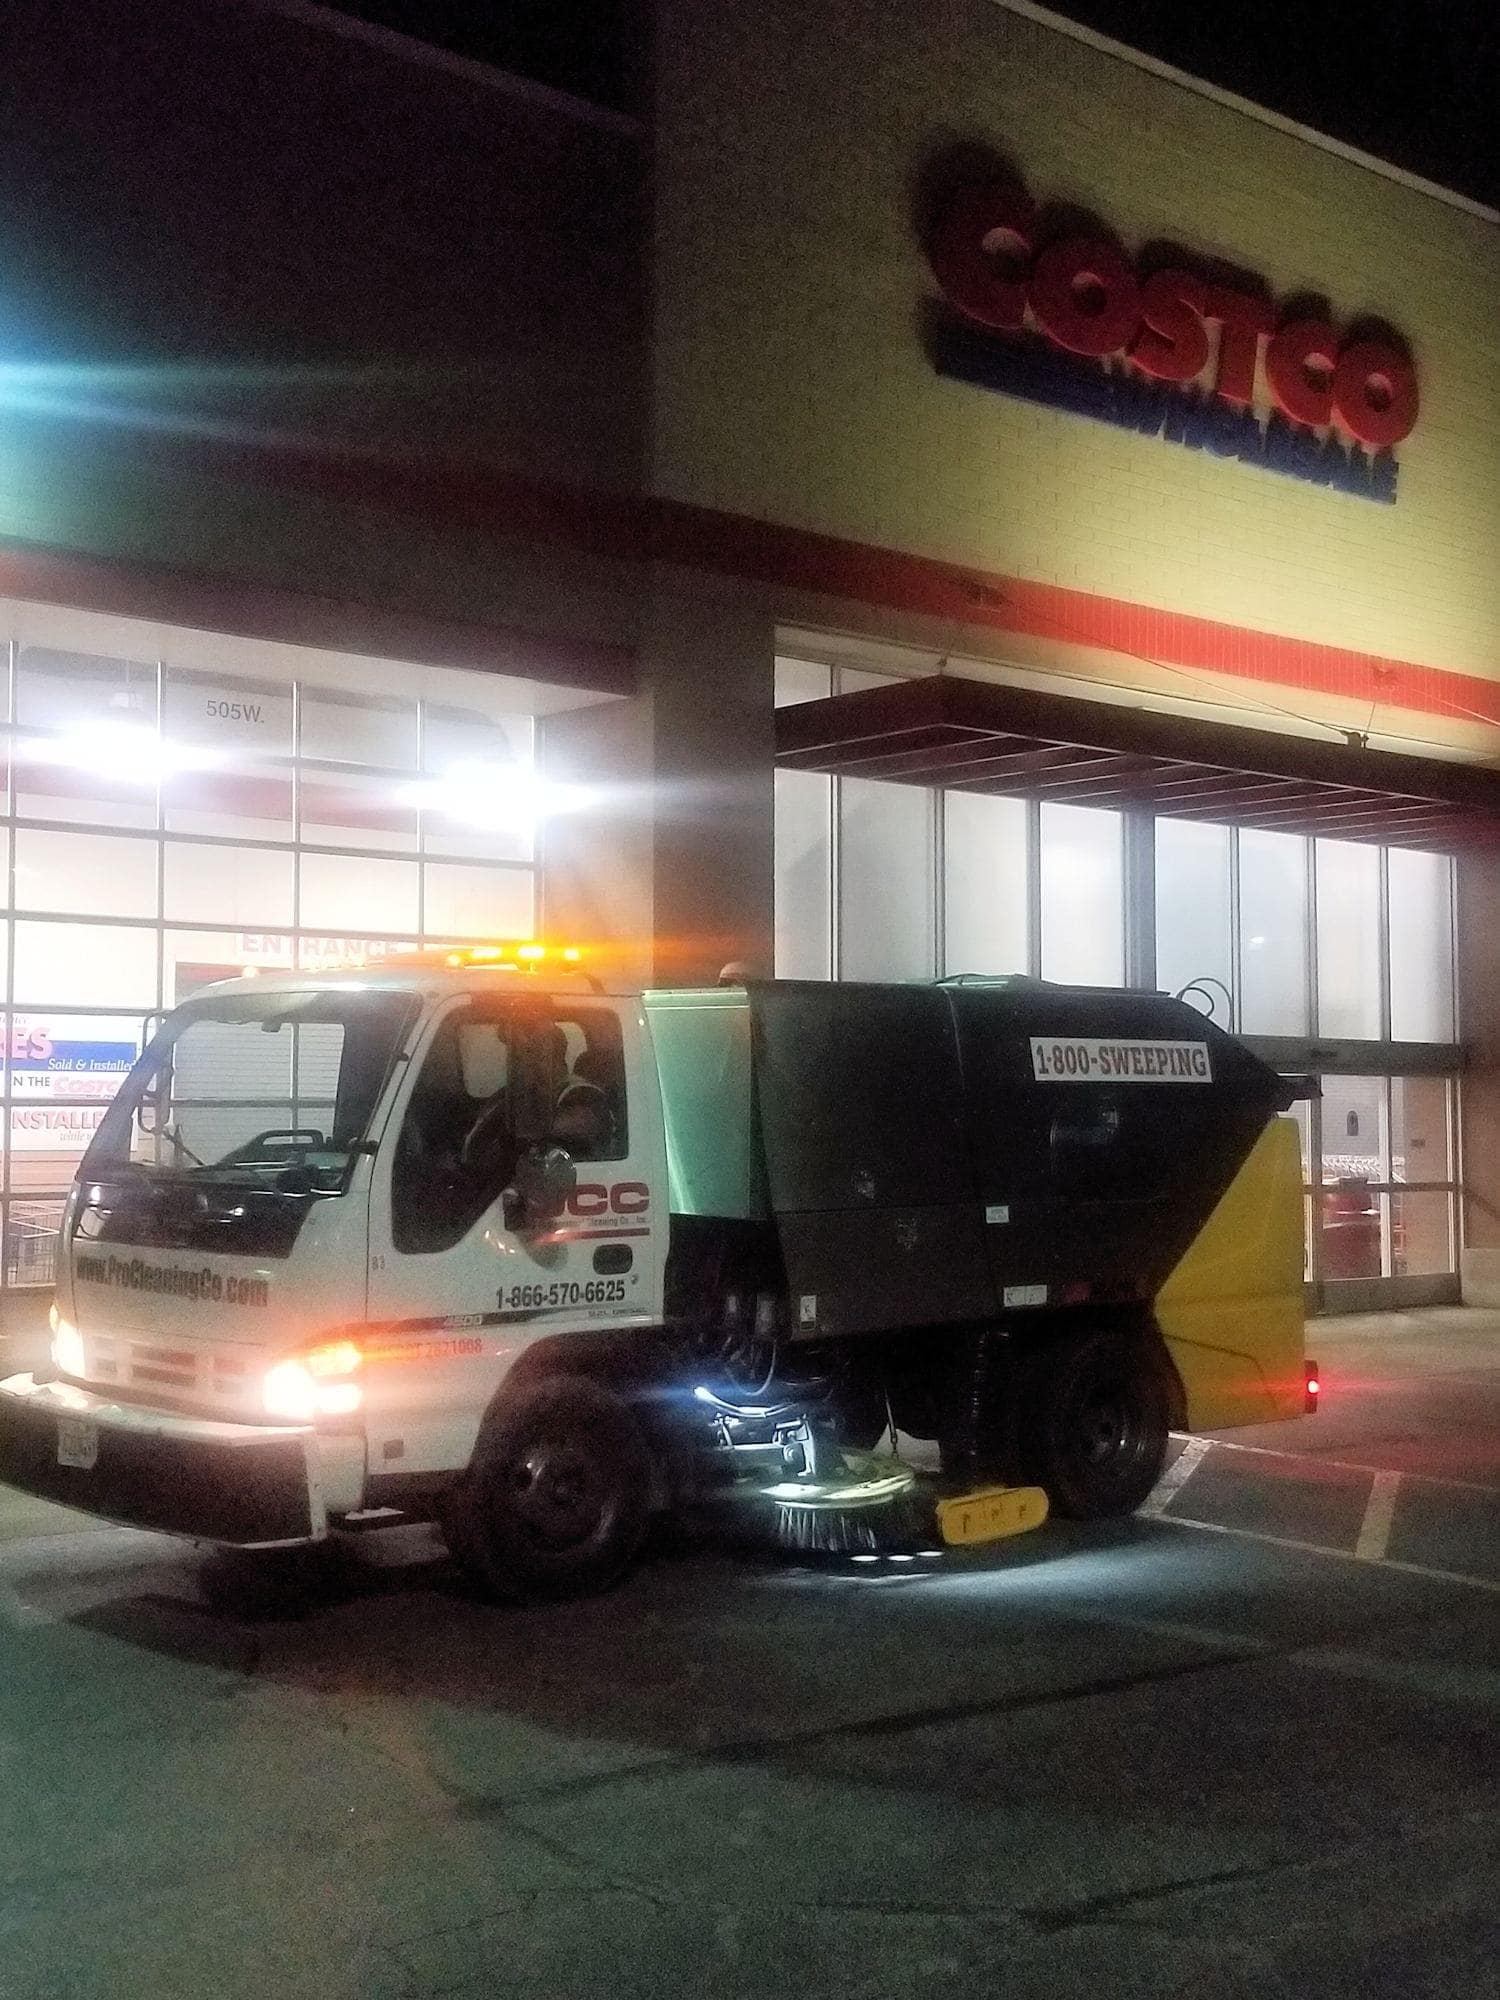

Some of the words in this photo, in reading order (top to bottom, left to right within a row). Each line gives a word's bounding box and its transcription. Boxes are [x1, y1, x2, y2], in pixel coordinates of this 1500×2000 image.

[926, 176, 1420, 447] COSTCO
[243, 933, 399, 956] ENRANCE
[48, 1058, 72, 1072] Sold
[75, 1059, 87, 1071] &
[1036, 1044, 1207, 1077] 1-800-SWEEPING
[27, 1076, 51, 1087] THE
[496, 1279, 625, 1309] 1-866-570-6625
